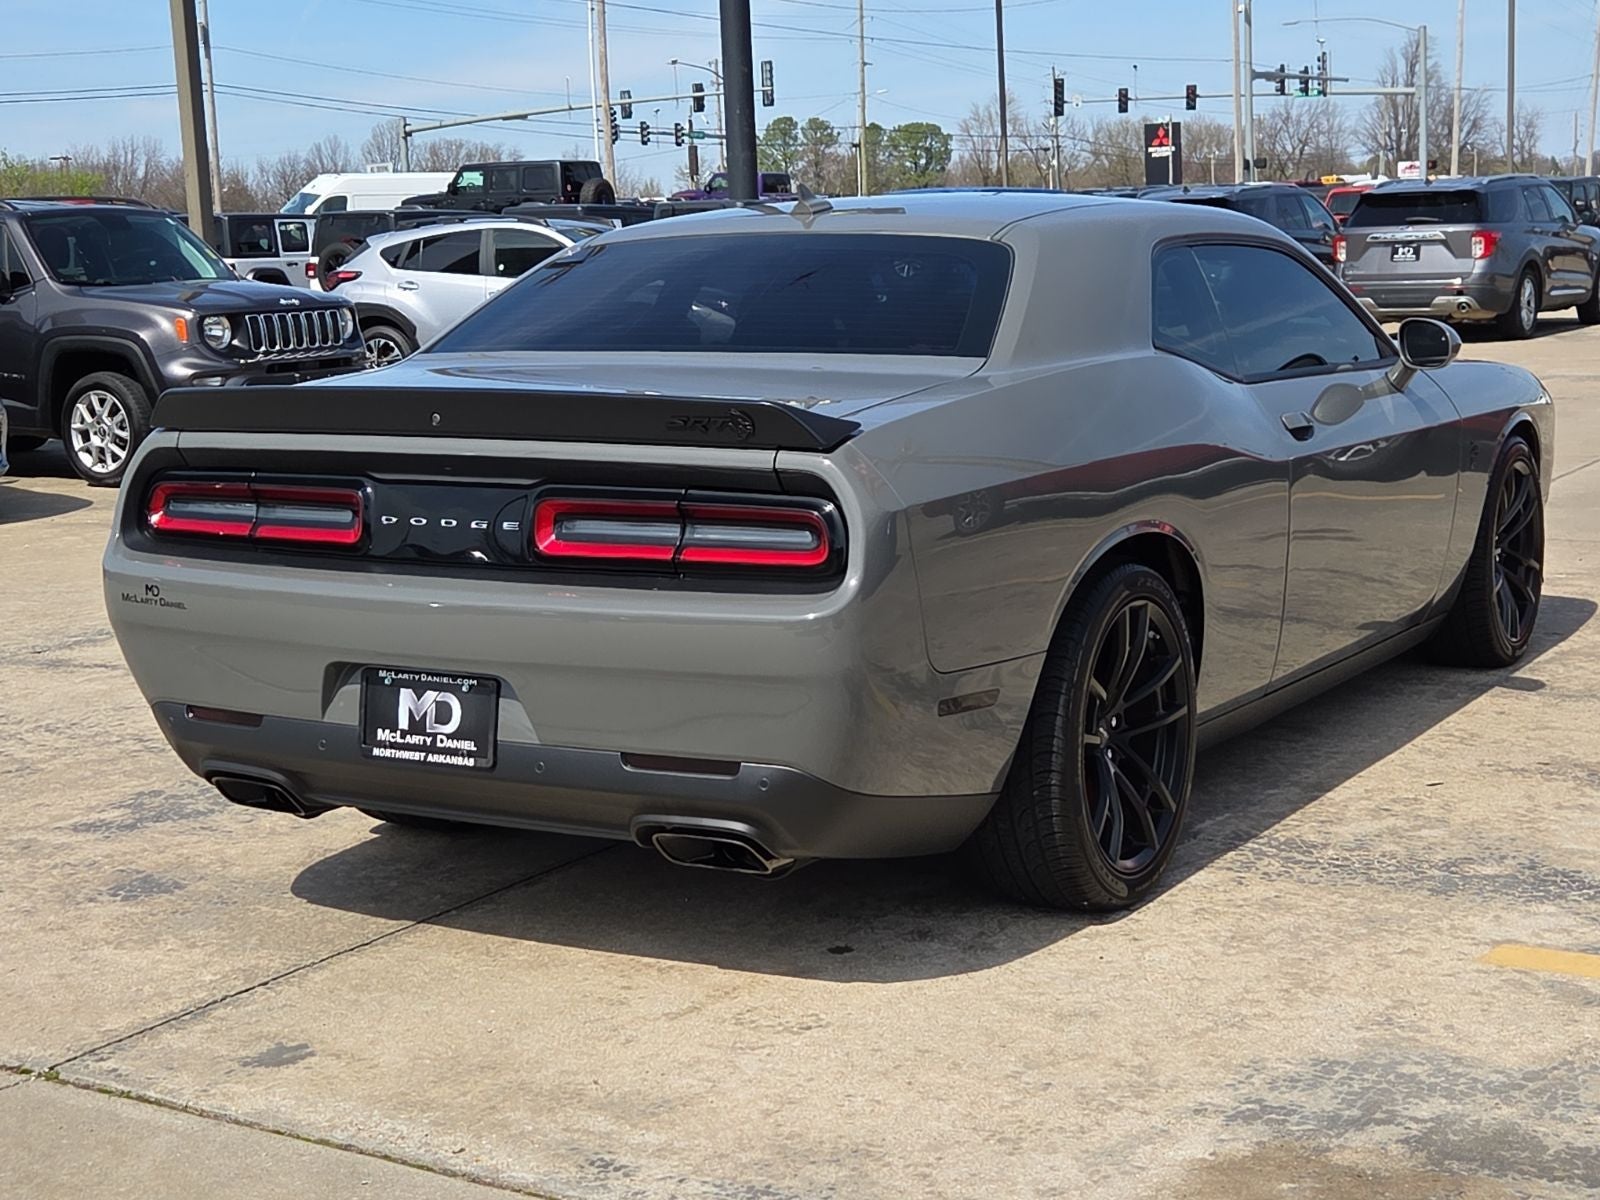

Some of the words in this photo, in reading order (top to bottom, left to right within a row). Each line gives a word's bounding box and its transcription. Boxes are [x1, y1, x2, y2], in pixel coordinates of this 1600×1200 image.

[381, 515, 520, 531] DODGE
[398, 687, 462, 734] MD
[436, 734, 478, 751] DANIEL
[372, 747, 427, 762] NORTHWEST
[426, 753, 476, 767] ARKANSAS
